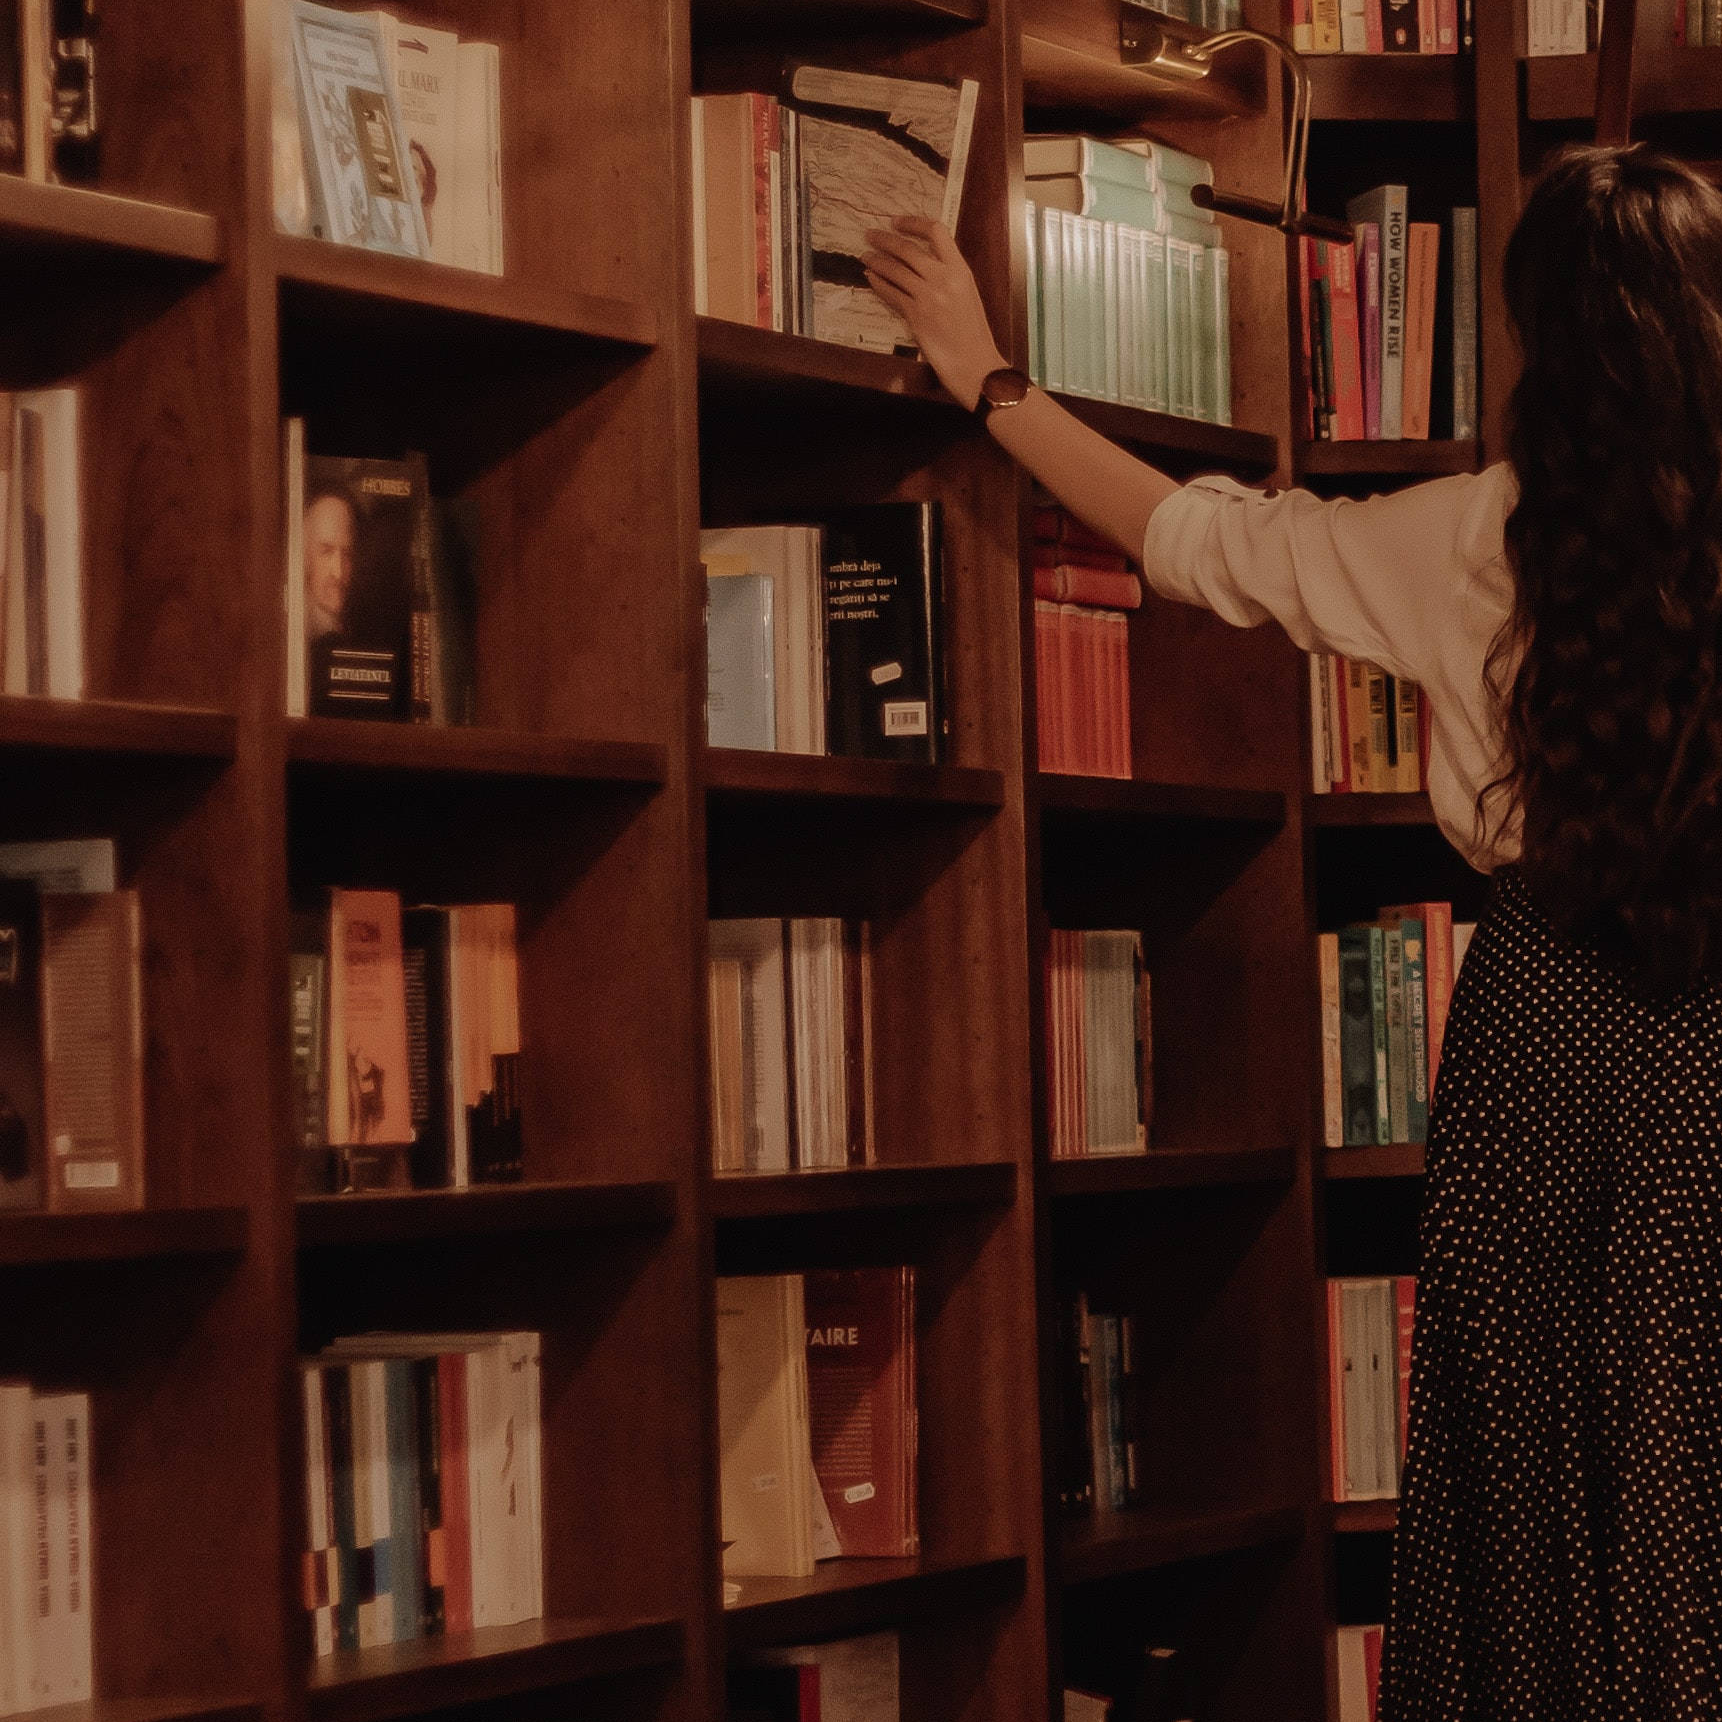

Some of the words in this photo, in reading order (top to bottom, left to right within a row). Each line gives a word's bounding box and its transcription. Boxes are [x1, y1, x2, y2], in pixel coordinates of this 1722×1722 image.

[1390, 211, 1402, 251] HOW
[1388, 257, 1402, 320] WOMEN
[1386, 326, 1400, 360] RISE
[1412, 981, 1423, 1025] SECRET
[1414, 1028, 1427, 1103] SISTERHOOD
